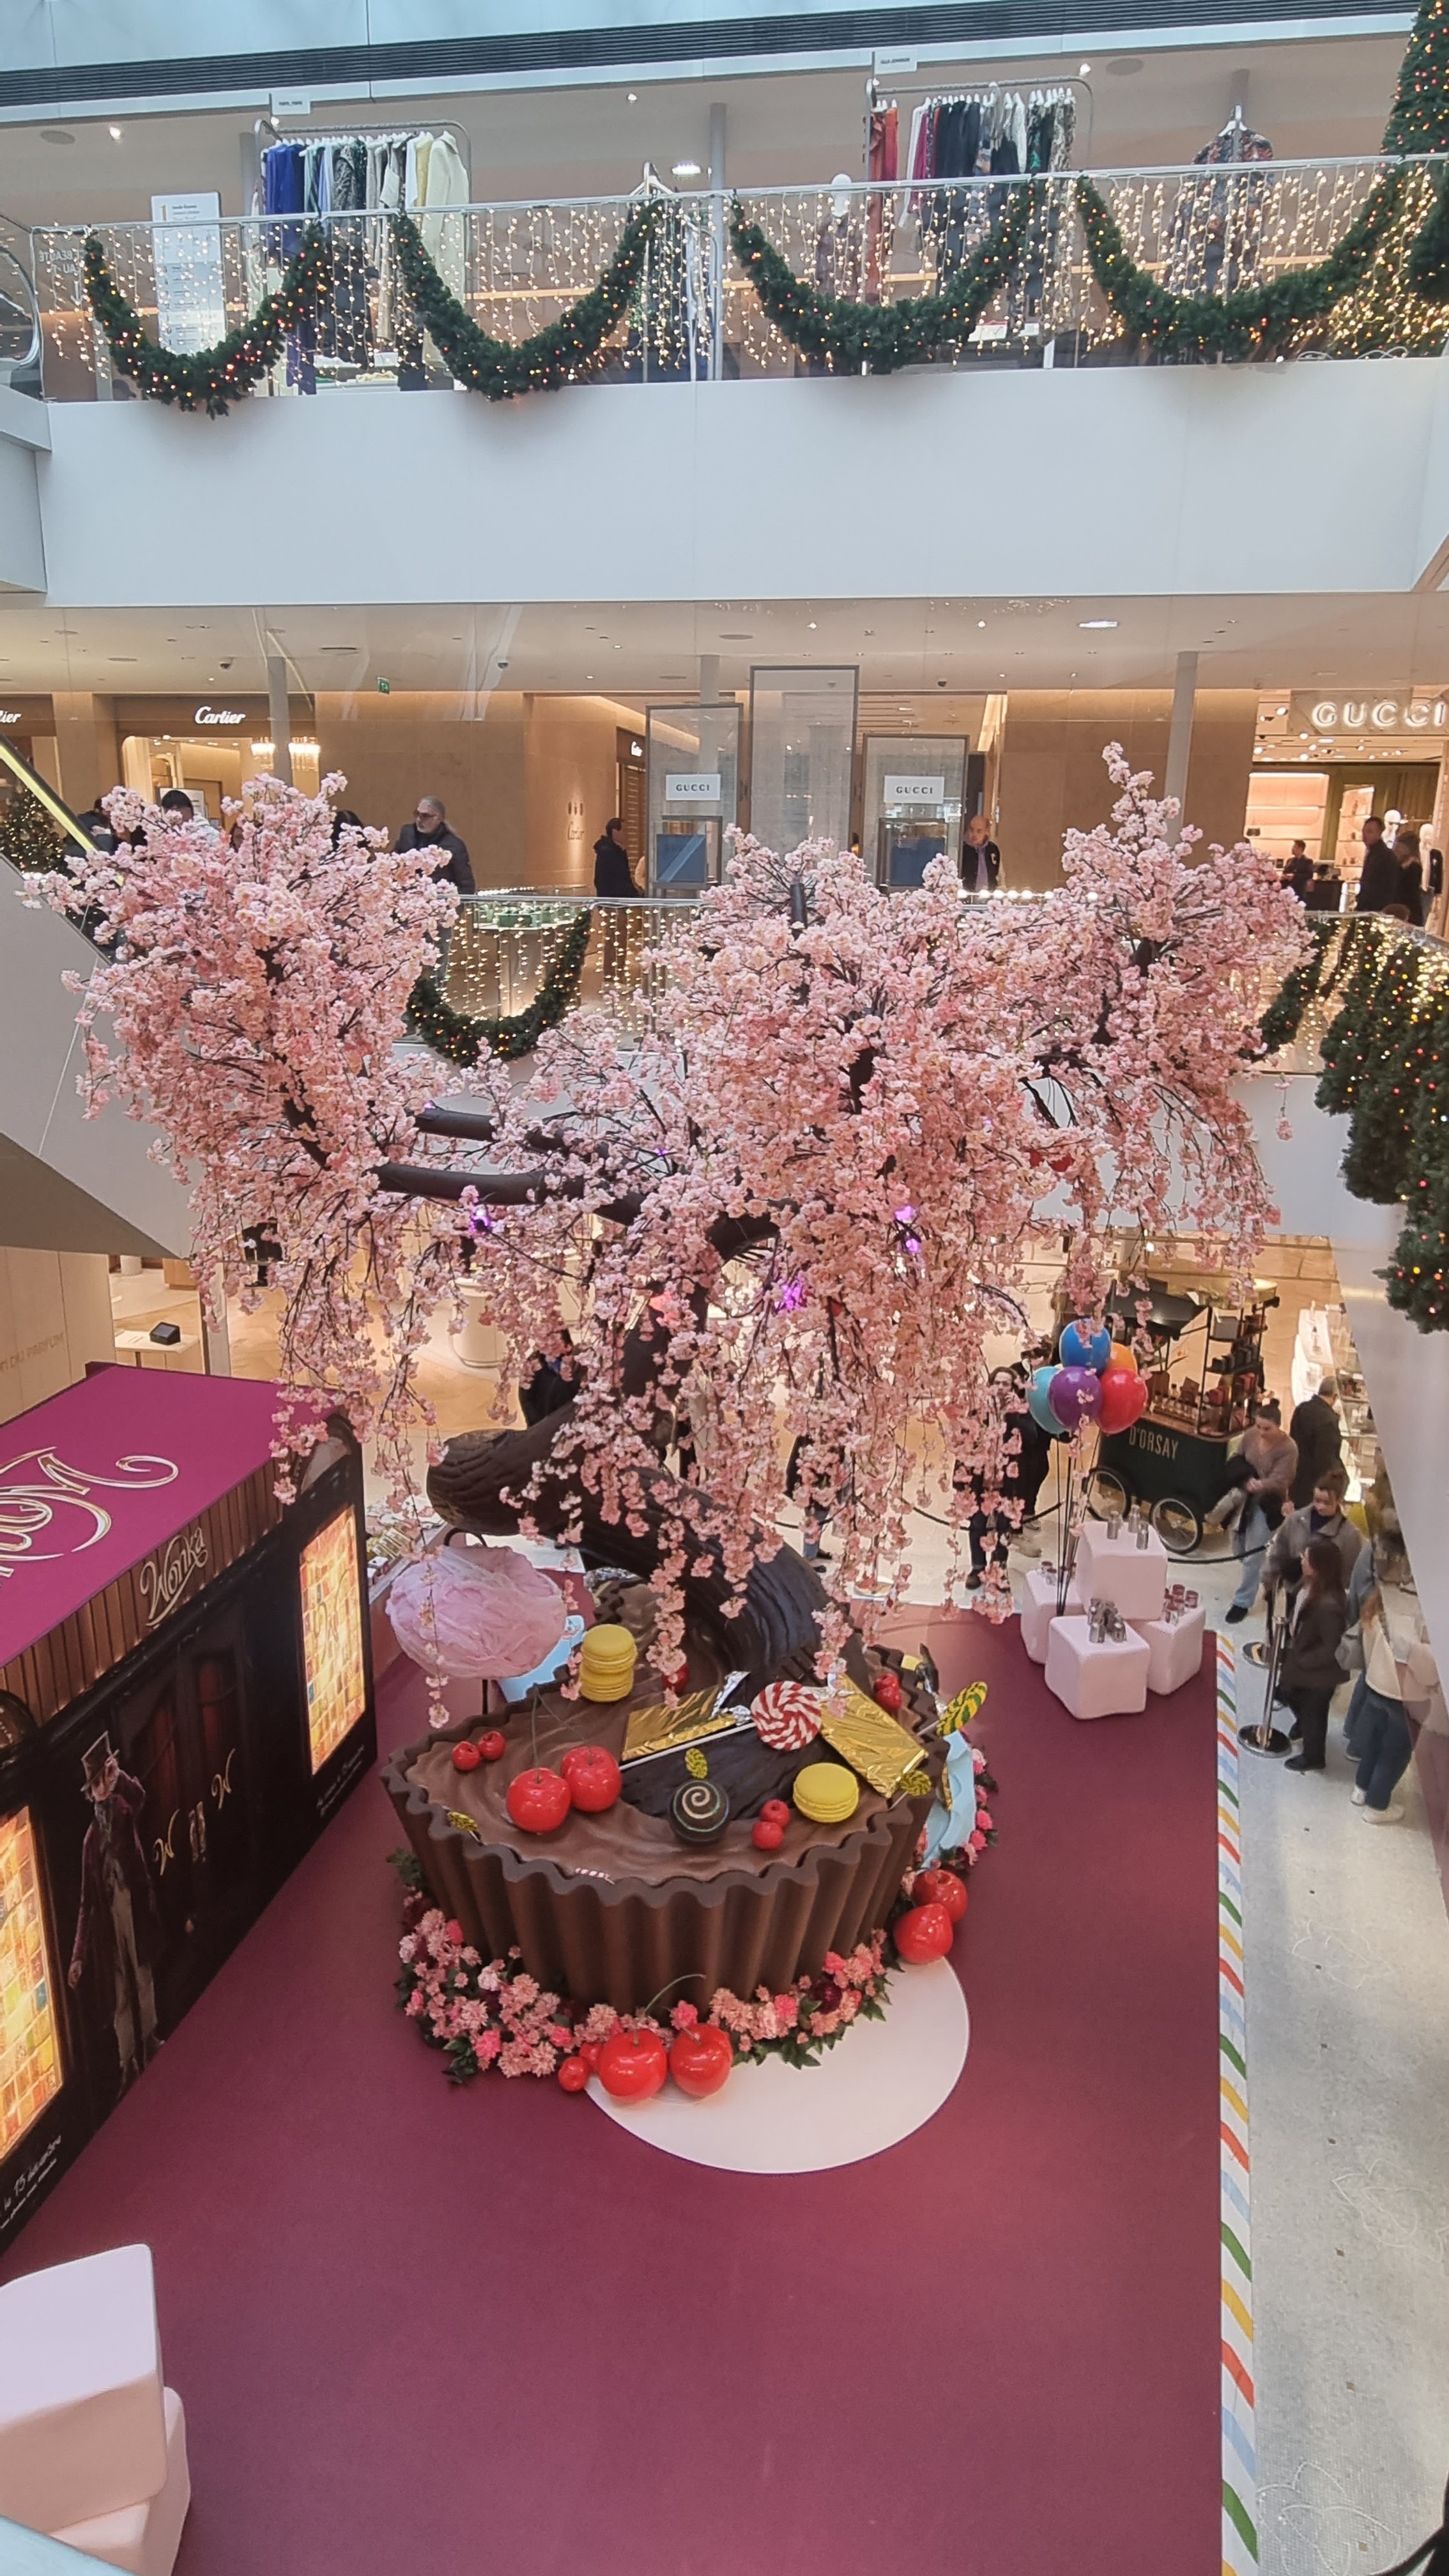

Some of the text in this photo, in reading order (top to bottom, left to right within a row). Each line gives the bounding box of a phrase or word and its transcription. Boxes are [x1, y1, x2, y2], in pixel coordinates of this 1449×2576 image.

[195, 706, 246, 724] Cartier
[1312, 701, 1447, 728] GUCCI
[675, 783, 710, 792] GUCCI
[896, 786, 933, 794] GUCCI
[1129, 1425, 1179, 1461] D'ORSAY
[140, 1527, 208, 1627] Wonka
[153, 1748, 236, 1876] W W
